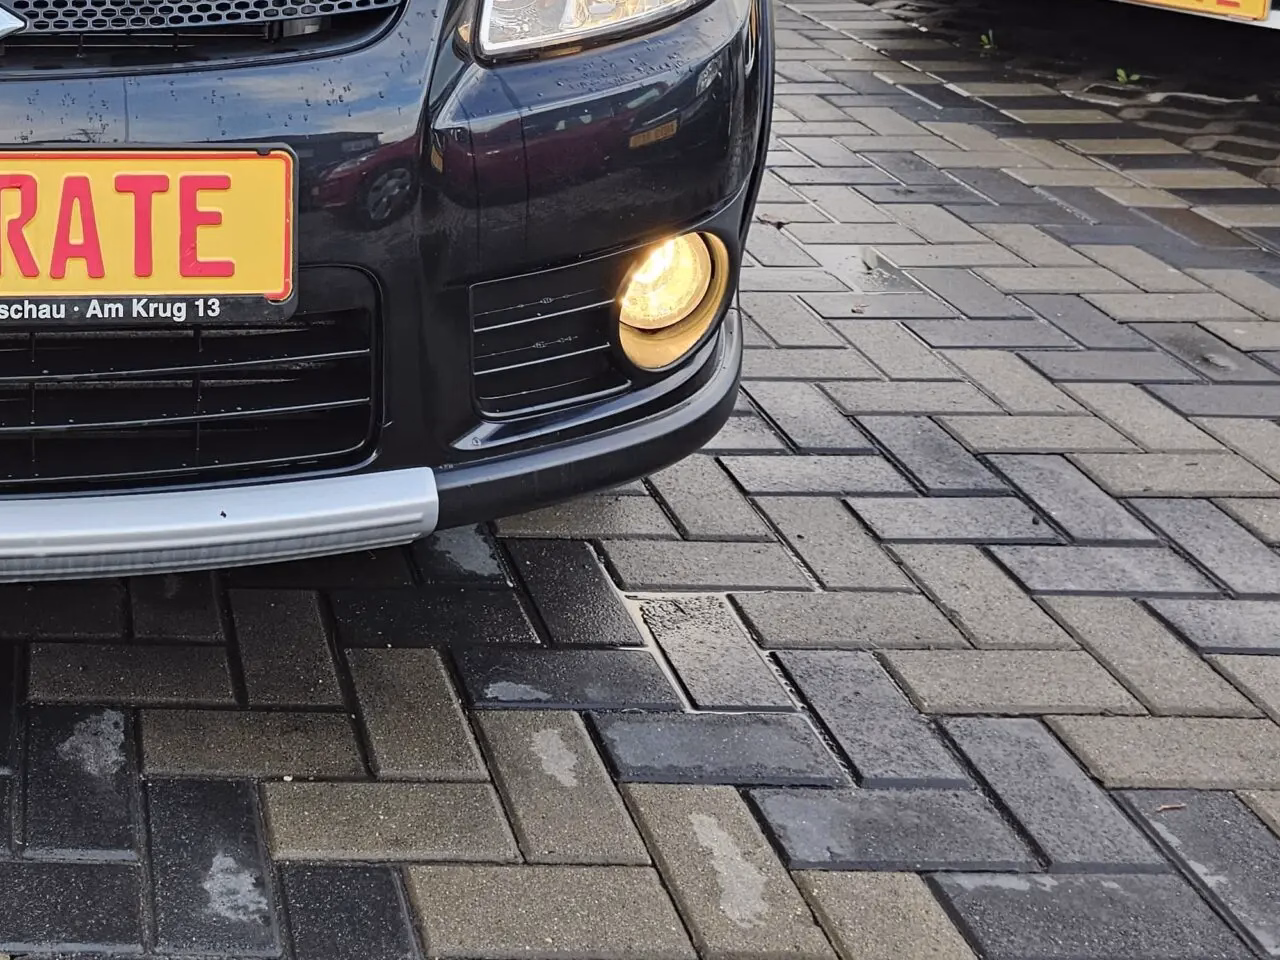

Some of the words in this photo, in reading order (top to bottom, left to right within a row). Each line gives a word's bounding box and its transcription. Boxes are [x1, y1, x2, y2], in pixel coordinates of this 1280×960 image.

[86, 298, 124, 319] Am
[132, 297, 188, 322] Krug
[194, 297, 221, 318] 13
